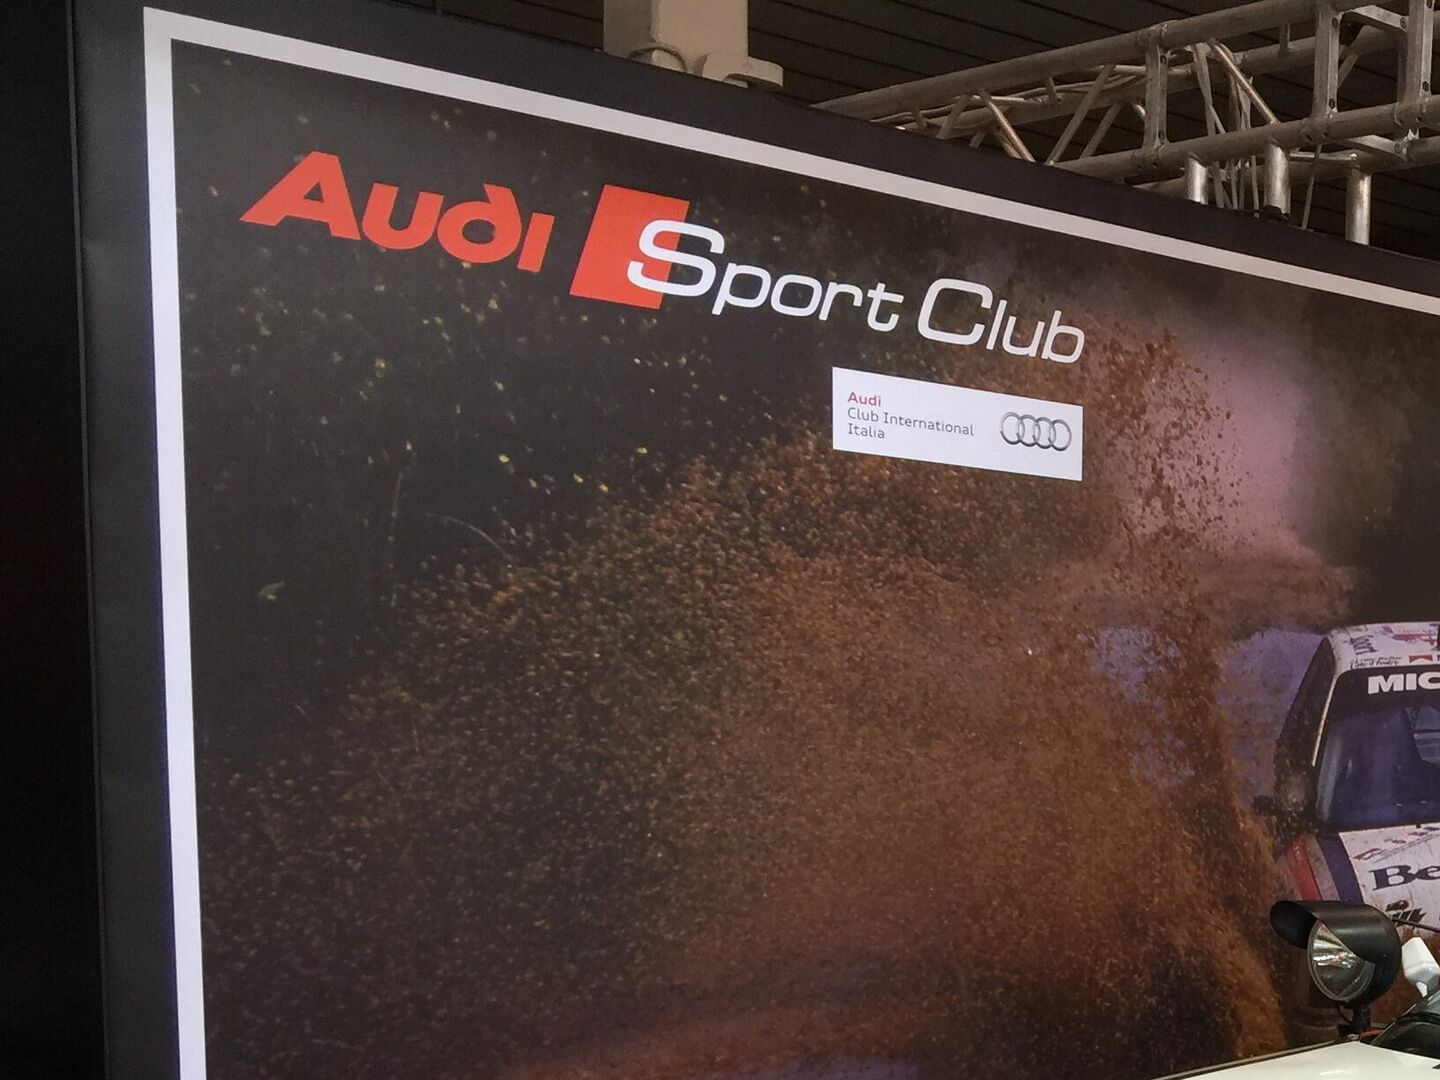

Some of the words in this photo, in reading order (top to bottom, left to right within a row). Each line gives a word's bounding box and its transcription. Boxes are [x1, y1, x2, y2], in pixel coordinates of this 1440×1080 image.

[240, 150, 554, 273] Audi
[626, 219, 905, 332] Sport
[917, 278, 1086, 365] Club
[847, 391, 881, 406] Audi
[847, 407, 880, 423] Club
[883, 412, 975, 437] International
[847, 423, 885, 439] Italia
